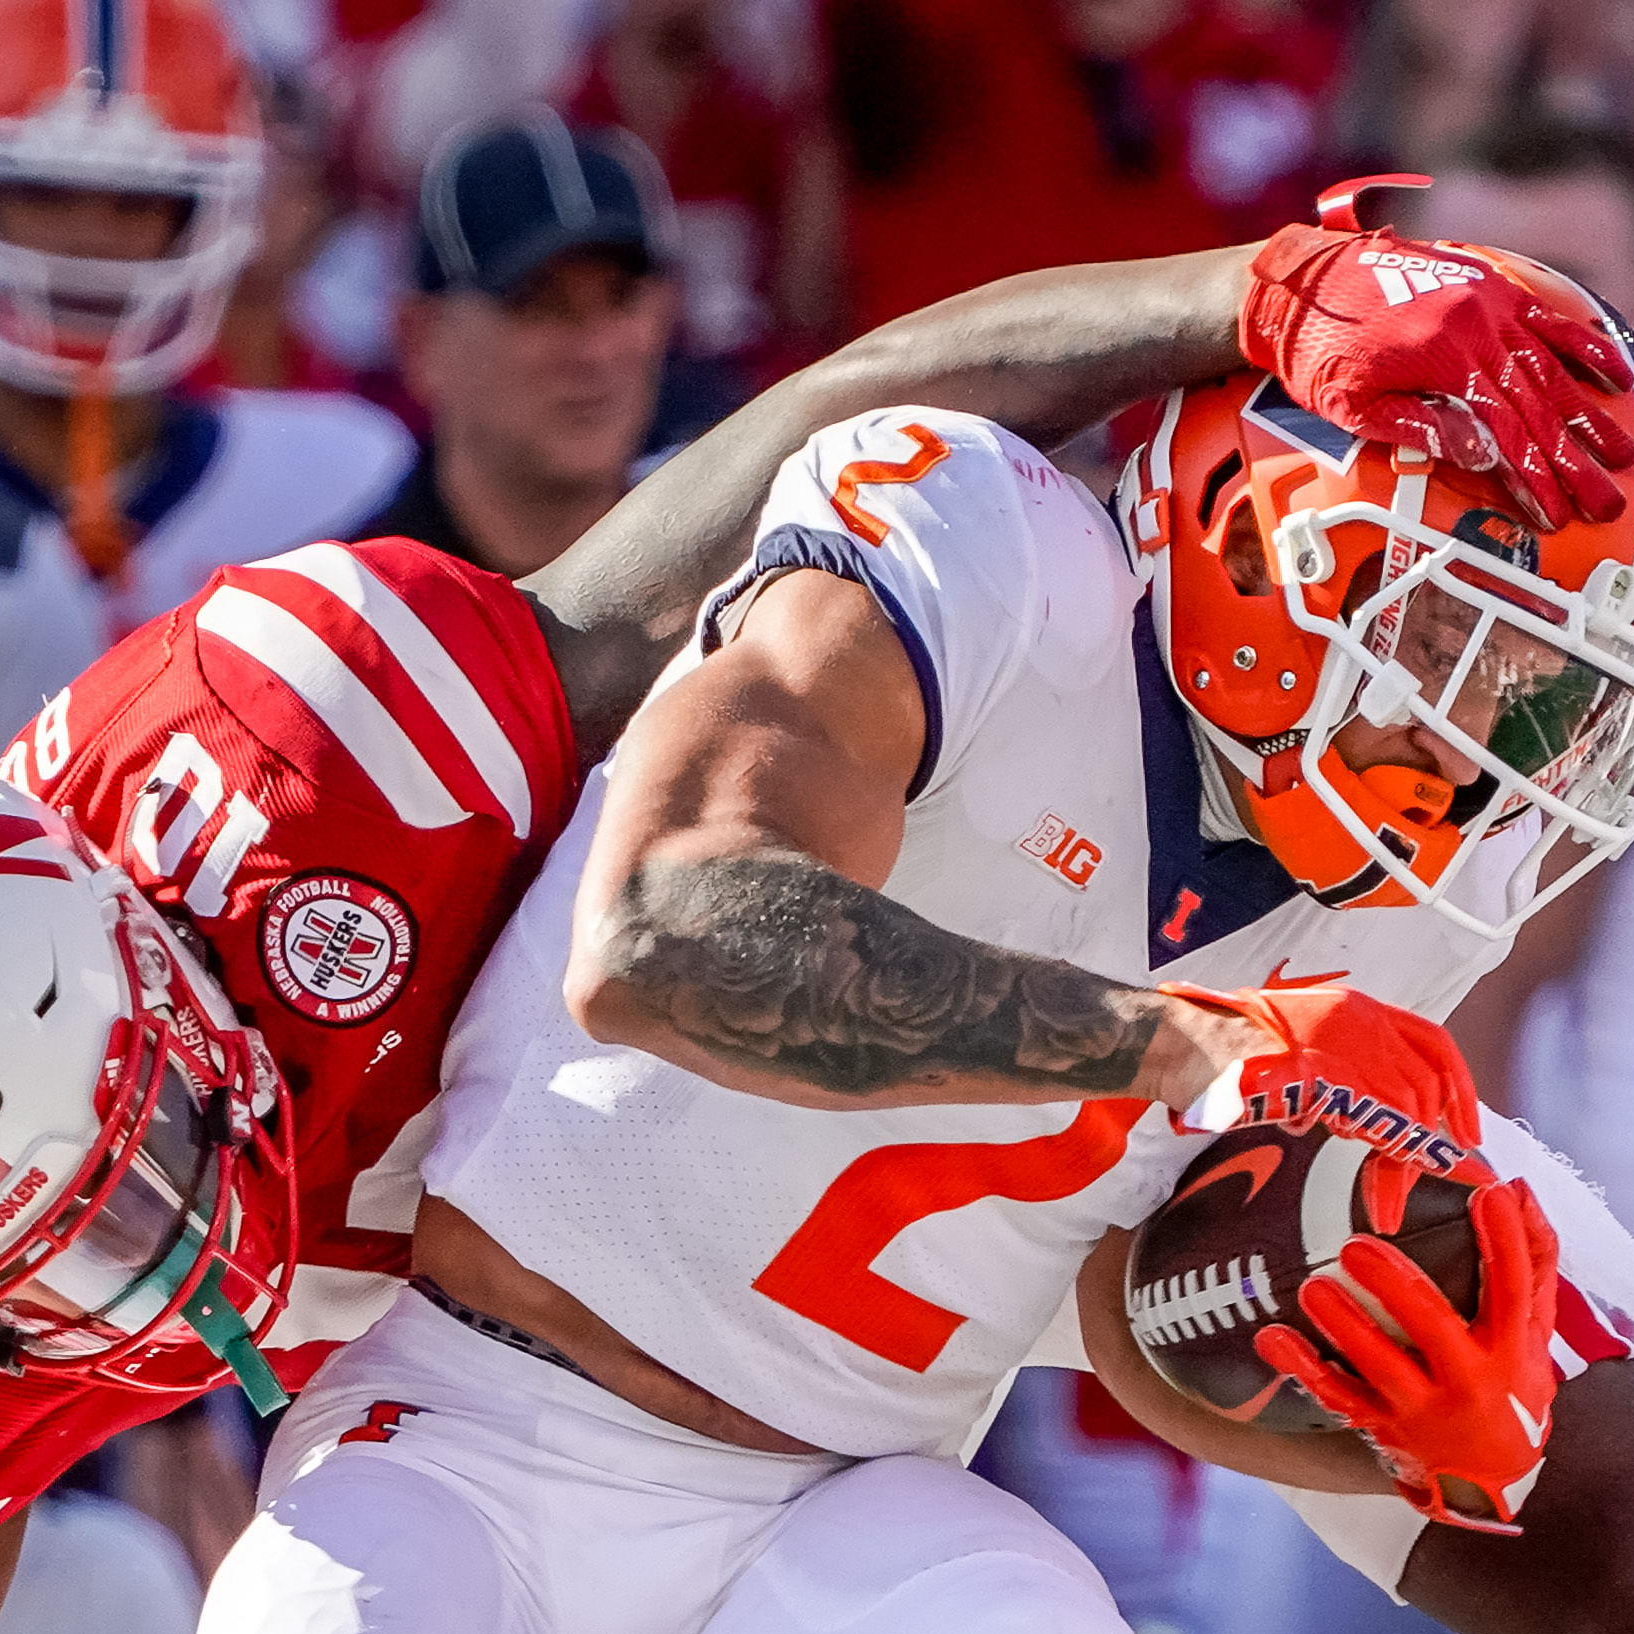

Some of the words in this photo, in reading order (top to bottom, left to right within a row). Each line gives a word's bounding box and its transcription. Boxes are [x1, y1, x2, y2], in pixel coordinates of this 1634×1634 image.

[1358, 250, 1485, 283] adidas
[829, 422, 952, 548] 2
[130, 731, 270, 918] 10
[276, 879, 351, 913] FOOTBALL
[369, 896, 412, 966] TRADITION
[1162, 888, 1203, 943] I
[267, 915, 303, 1001] NEBRASKA
[309, 910, 363, 992] HUSKERS
[316, 1002, 329, 1018] A
[336, 973, 403, 1020] WINNING
[751, 1097, 1154, 1374] 2
